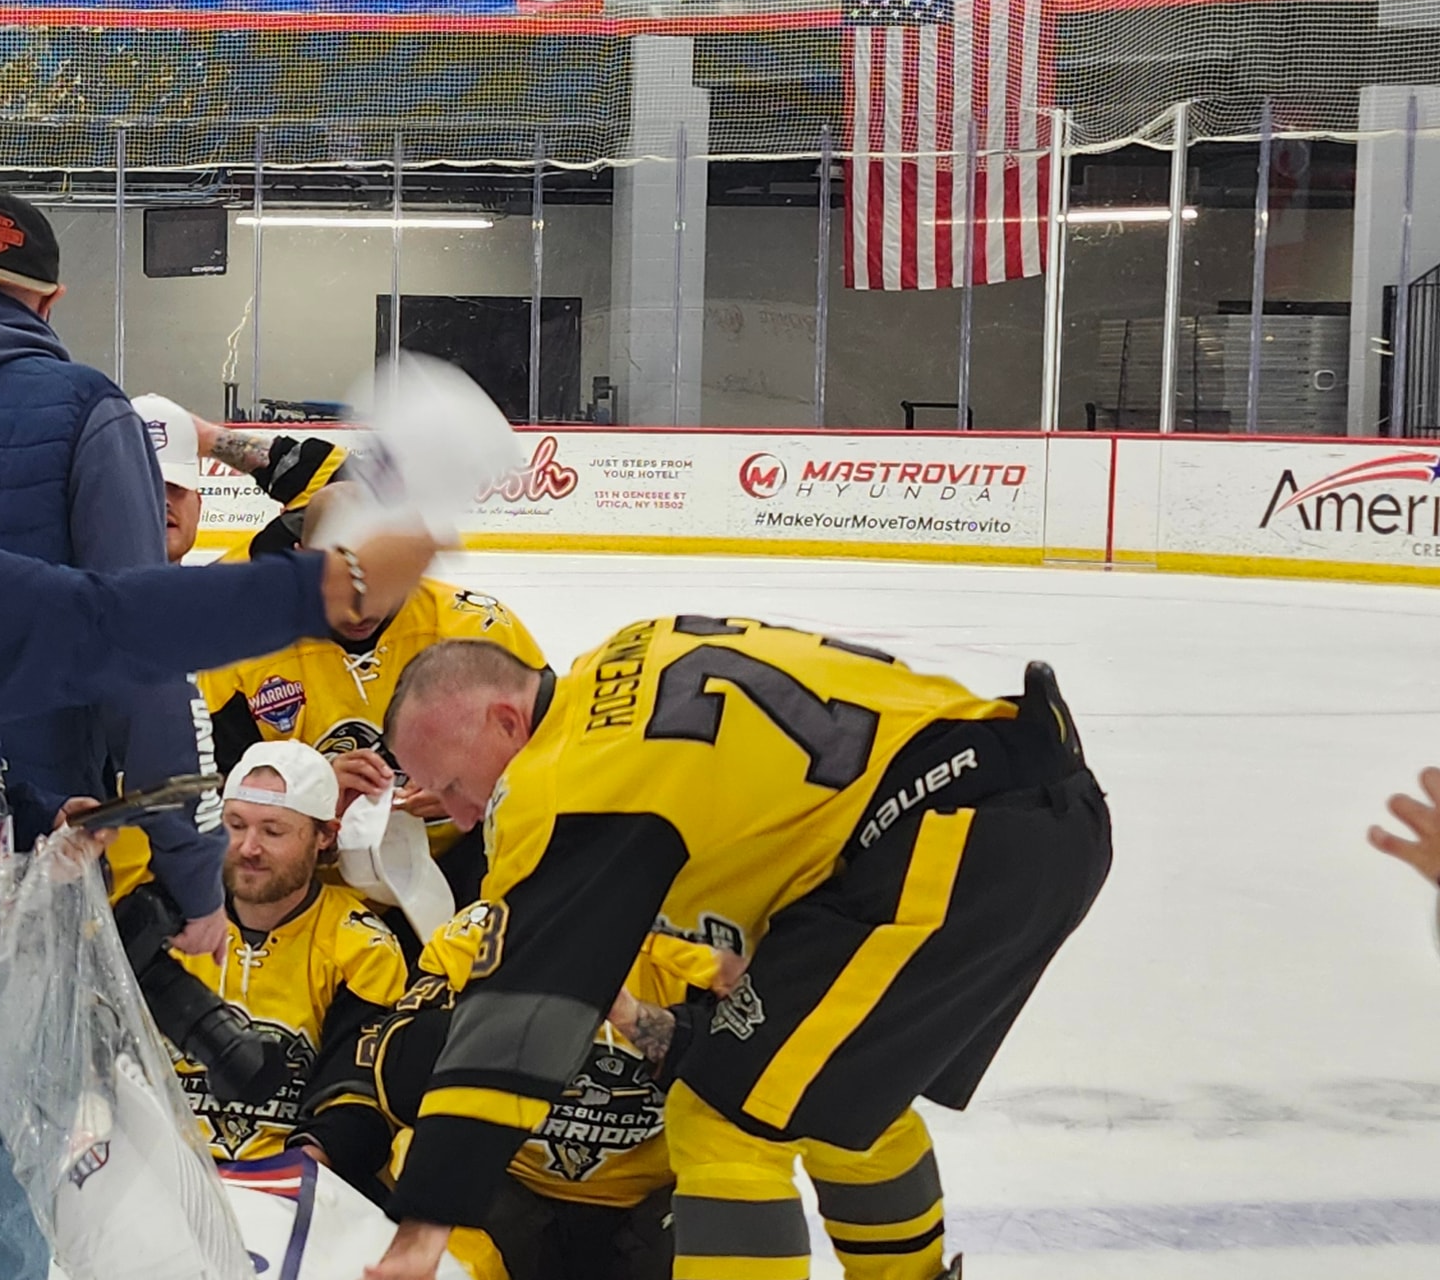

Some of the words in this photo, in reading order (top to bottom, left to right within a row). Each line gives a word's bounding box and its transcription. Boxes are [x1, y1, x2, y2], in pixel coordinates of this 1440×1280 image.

[589, 459, 618, 468] JUST
[622, 459, 657, 468] STEPS
[660, 460, 693, 469] FROM
[603, 470, 635, 479] YOUR
[801, 461, 1027, 487] MASTROVITO
[796, 483, 1020, 502] HYUNDAI
[635, 501, 651, 509] NY
[202, 511, 225, 523] iles
[755, 511, 1011, 533] #MakeYourMoveToMastrovito
[248, 681, 304, 709] WARRIOR
[553, 1104, 652, 1125] TSBURGH
